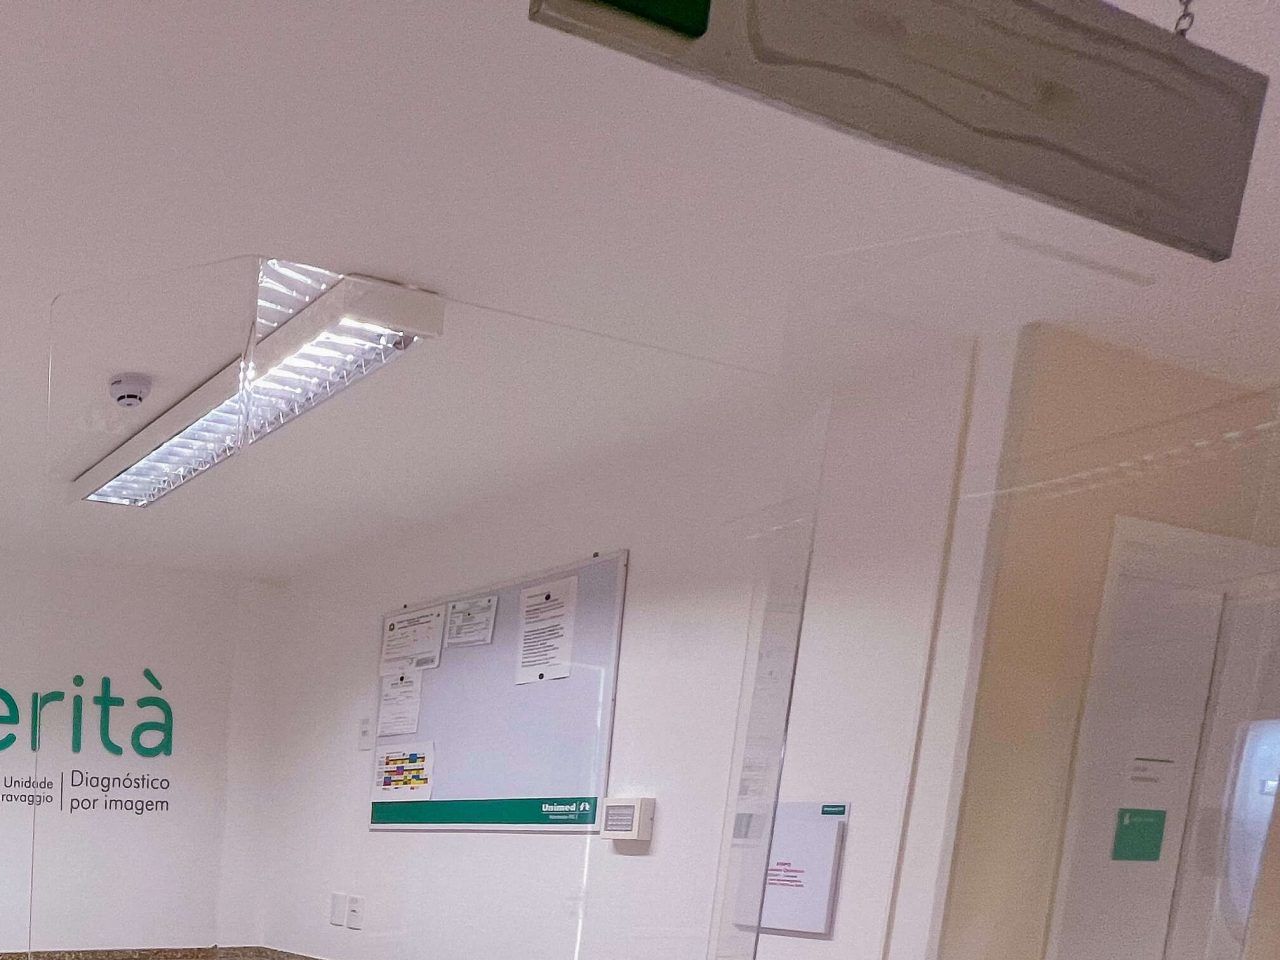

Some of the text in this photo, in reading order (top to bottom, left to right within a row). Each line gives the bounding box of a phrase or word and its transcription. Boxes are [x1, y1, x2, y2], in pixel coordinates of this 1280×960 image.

[4, 776, 54, 789] Unidade
[71, 769, 170, 792] Diagnóstico
[70, 795, 169, 815] por imagem
[542, 802, 576, 811] Unimed
